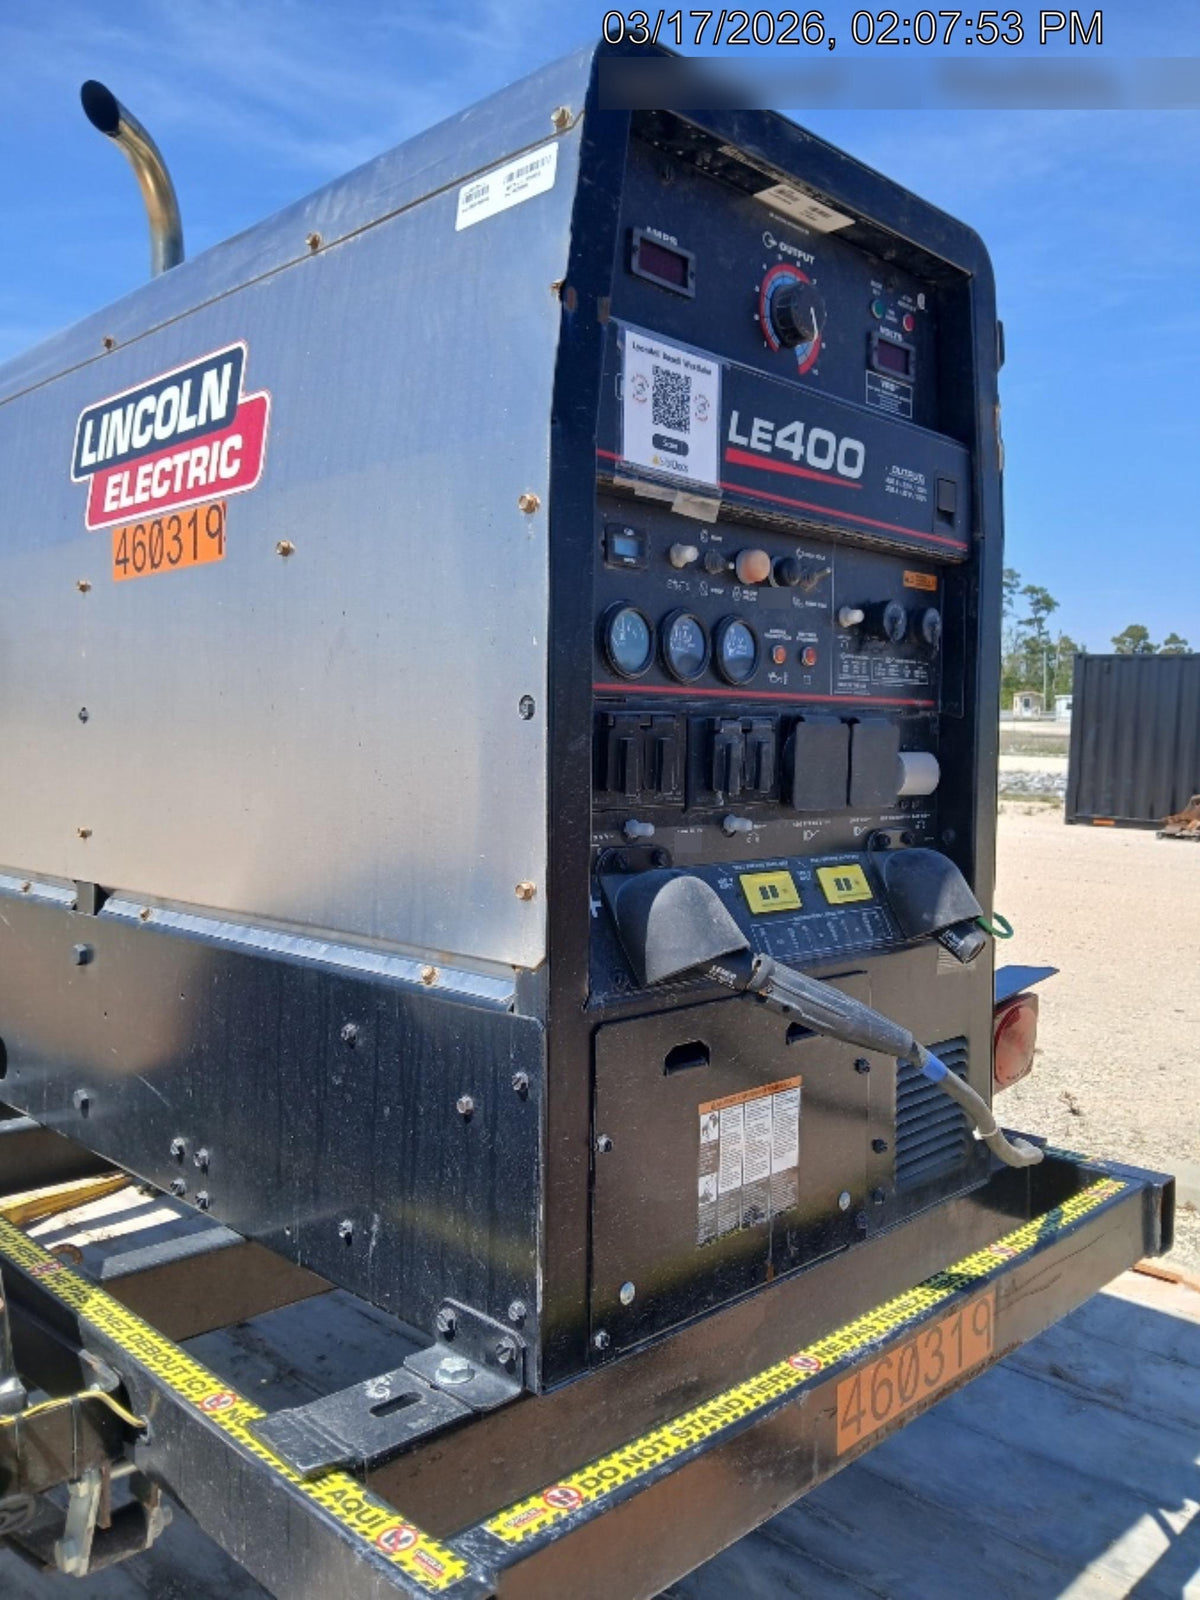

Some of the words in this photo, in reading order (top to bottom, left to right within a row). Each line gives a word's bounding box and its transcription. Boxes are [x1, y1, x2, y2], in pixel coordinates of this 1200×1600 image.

[778, 241, 815, 264] OUTPUT
[81, 362, 233, 467] LINCOLN
[728, 410, 865, 479] LE400
[103, 434, 242, 512] ELECTRIC
[115, 504, 225, 575] 460319
[88, 1301, 131, 1333] TENEZ
[128, 1330, 189, 1377] DEBOUT
[841, 1298, 991, 1435] 460319
[579, 1466, 621, 1491] DO
[620, 1438, 671, 1468] NOT
[670, 1398, 746, 1439] STAND
[742, 1368, 800, 1400] HERE
[814, 1342, 844, 1358] NE
[840, 1323, 877, 1343] PAS
